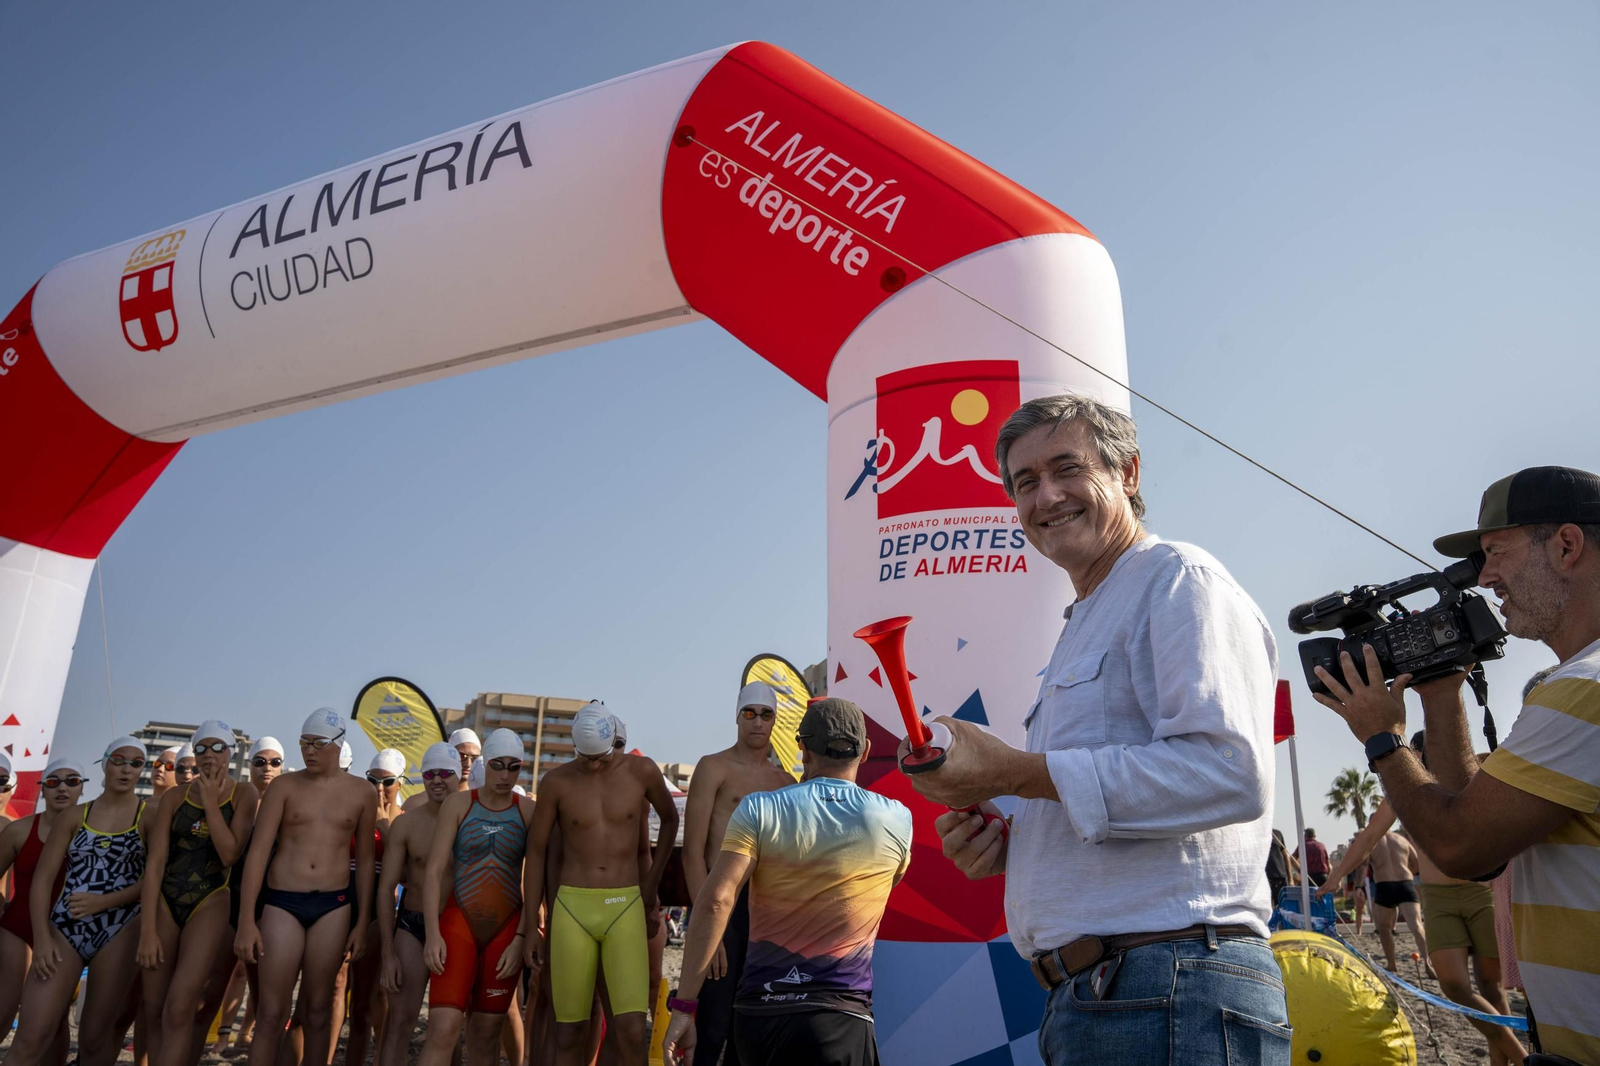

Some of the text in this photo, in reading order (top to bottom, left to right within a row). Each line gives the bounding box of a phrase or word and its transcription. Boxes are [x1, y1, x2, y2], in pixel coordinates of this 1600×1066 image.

[229, 120, 533, 259] ALMERÍA
[724, 110, 906, 234] ALMERÍA
[699, 150, 869, 276] es deporte
[230, 237, 374, 311] CIUDAD
[878, 518, 939, 535] PATRONATO
[943, 515, 1007, 526] MUNICIPAL
[879, 528, 1026, 559] DEPORTES
[879, 555, 1028, 582] DE ALMERIA
[605, 896, 627, 904] arena
